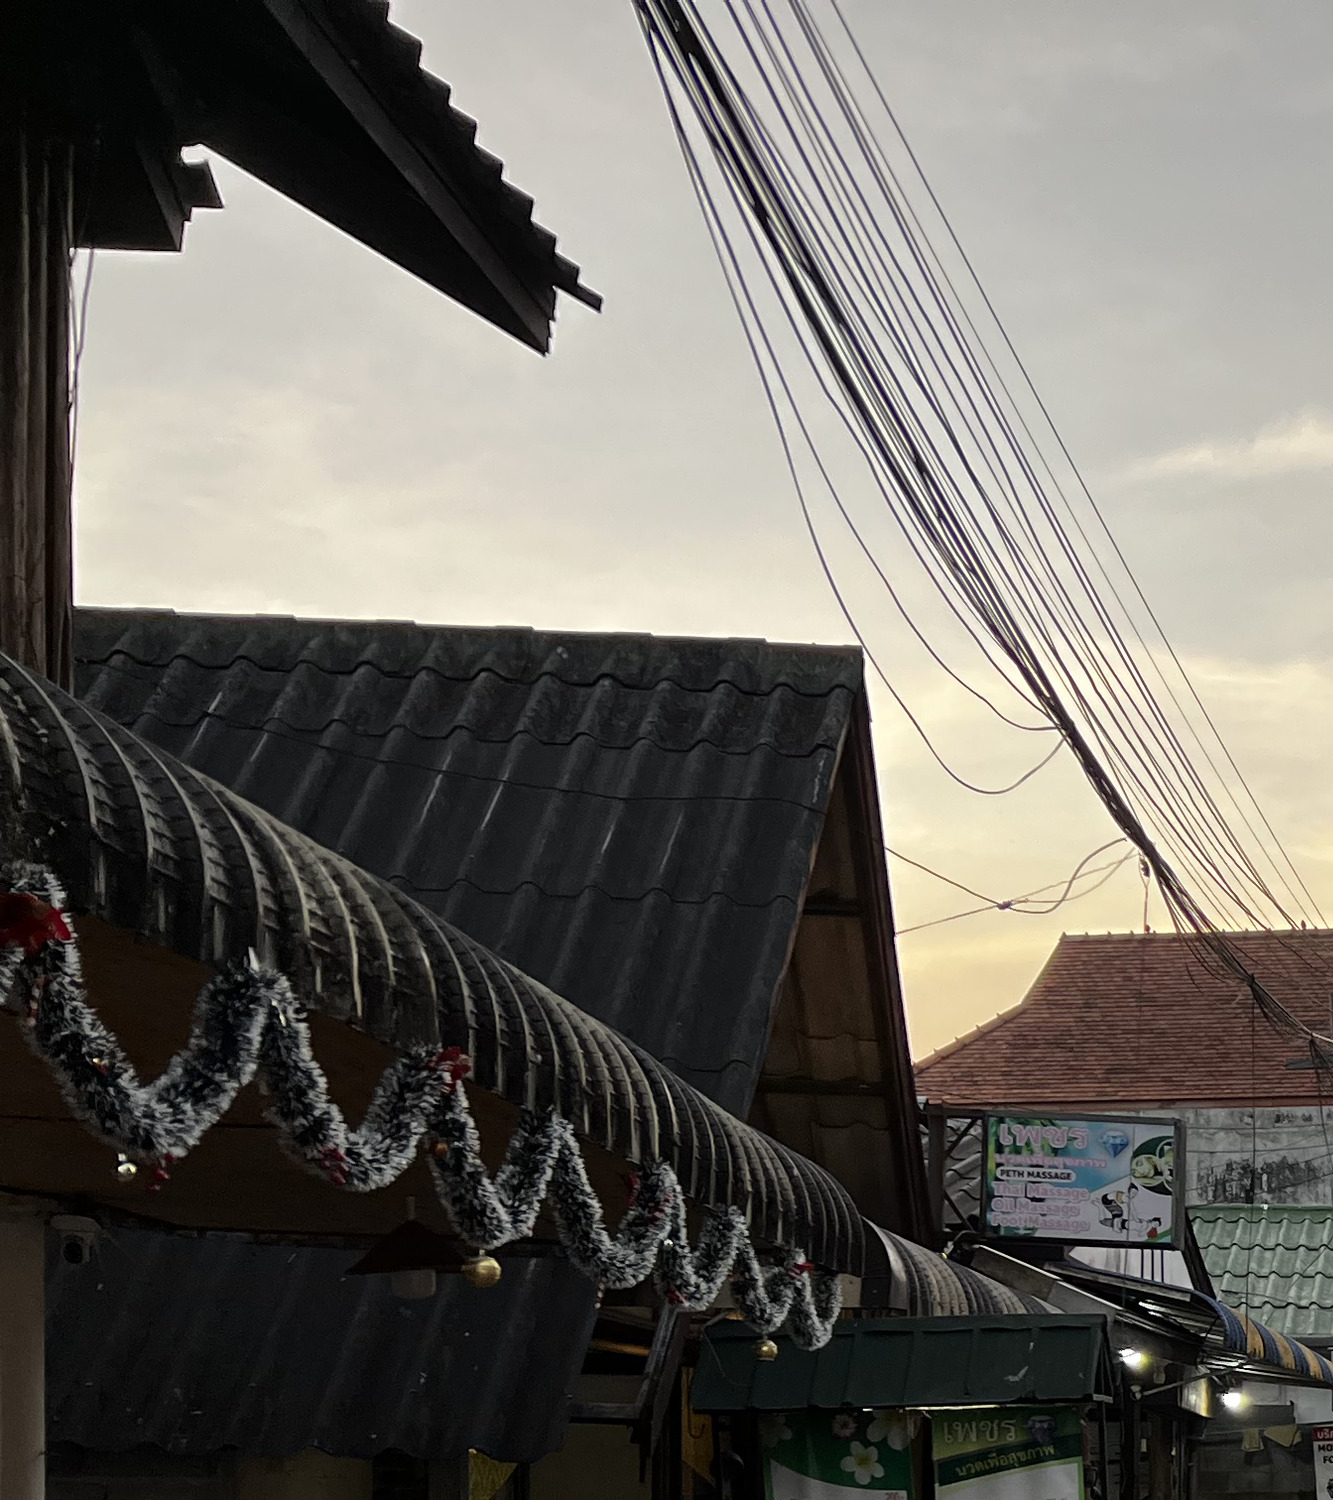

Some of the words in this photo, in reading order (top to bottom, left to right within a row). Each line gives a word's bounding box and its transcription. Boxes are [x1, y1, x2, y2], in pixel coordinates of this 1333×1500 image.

[1000, 1123, 1089, 1149] เพชร
[1027, 1170, 1073, 1181] MASSAGE
[994, 1183, 1024, 1197] Thai
[1027, 1184, 1089, 1202] Massage
[992, 1198, 1015, 1212] Oil
[1018, 1200, 1080, 1217] Massage
[993, 1213, 1024, 1227] Foot
[1026, 1214, 1089, 1232] Massage
[943, 1419, 1017, 1443] เพชร
